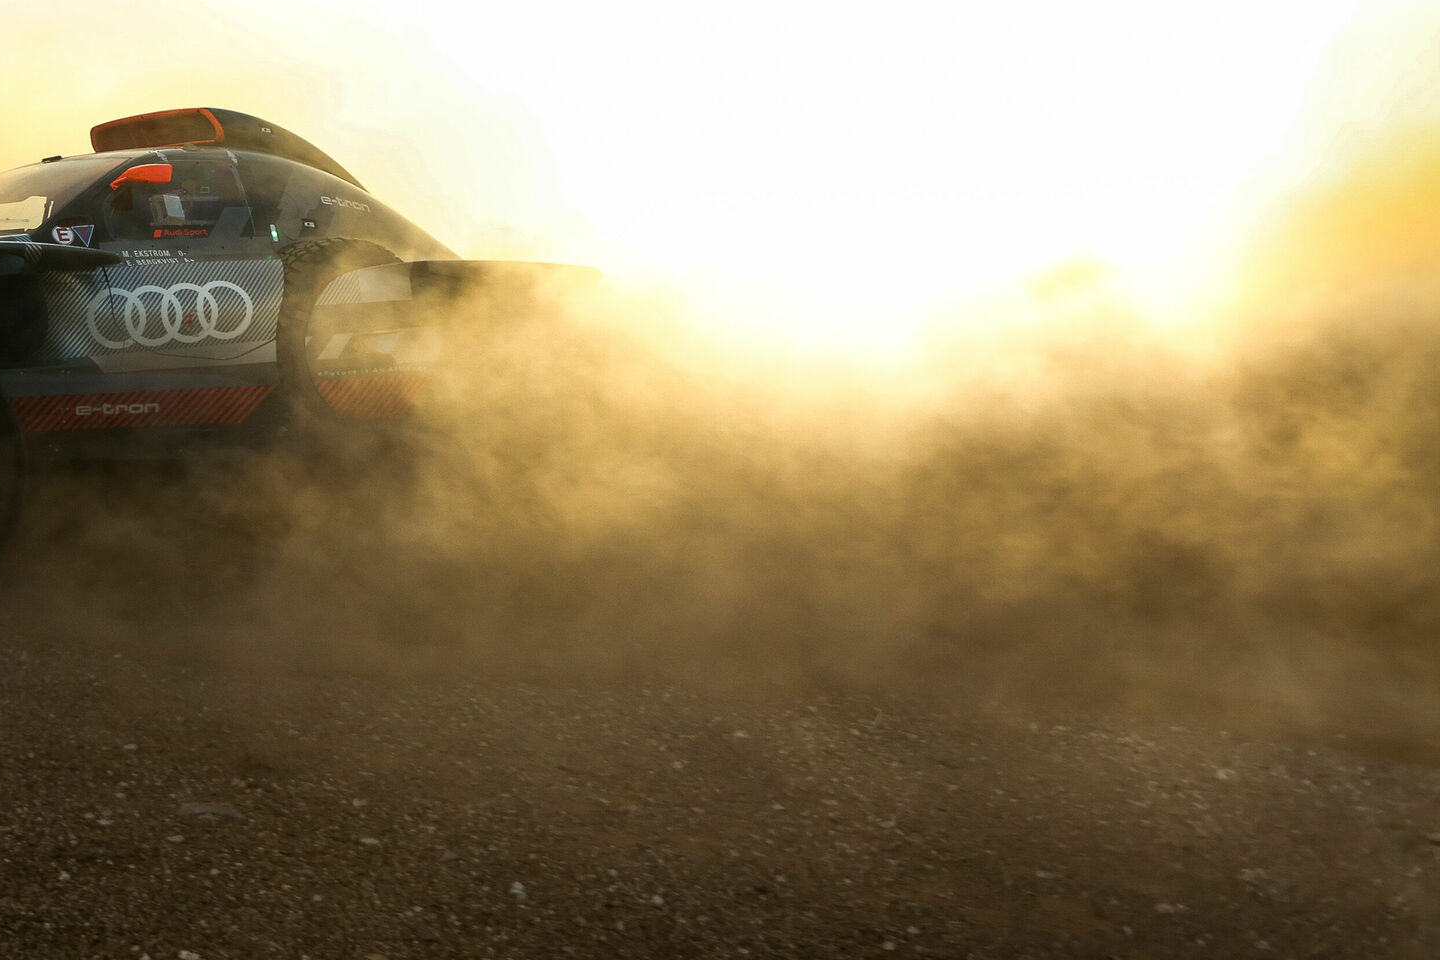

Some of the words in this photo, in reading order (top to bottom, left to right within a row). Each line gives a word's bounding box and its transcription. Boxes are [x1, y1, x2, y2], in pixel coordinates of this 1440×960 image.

[320, 196, 371, 212] e-tron
[56, 227, 70, 242] E
[184, 228, 208, 237] Sport
[122, 250, 133, 258] M.
[125, 259, 135, 267] E.
[136, 257, 179, 266] BERGKVIST
[76, 403, 159, 415] e-tron
